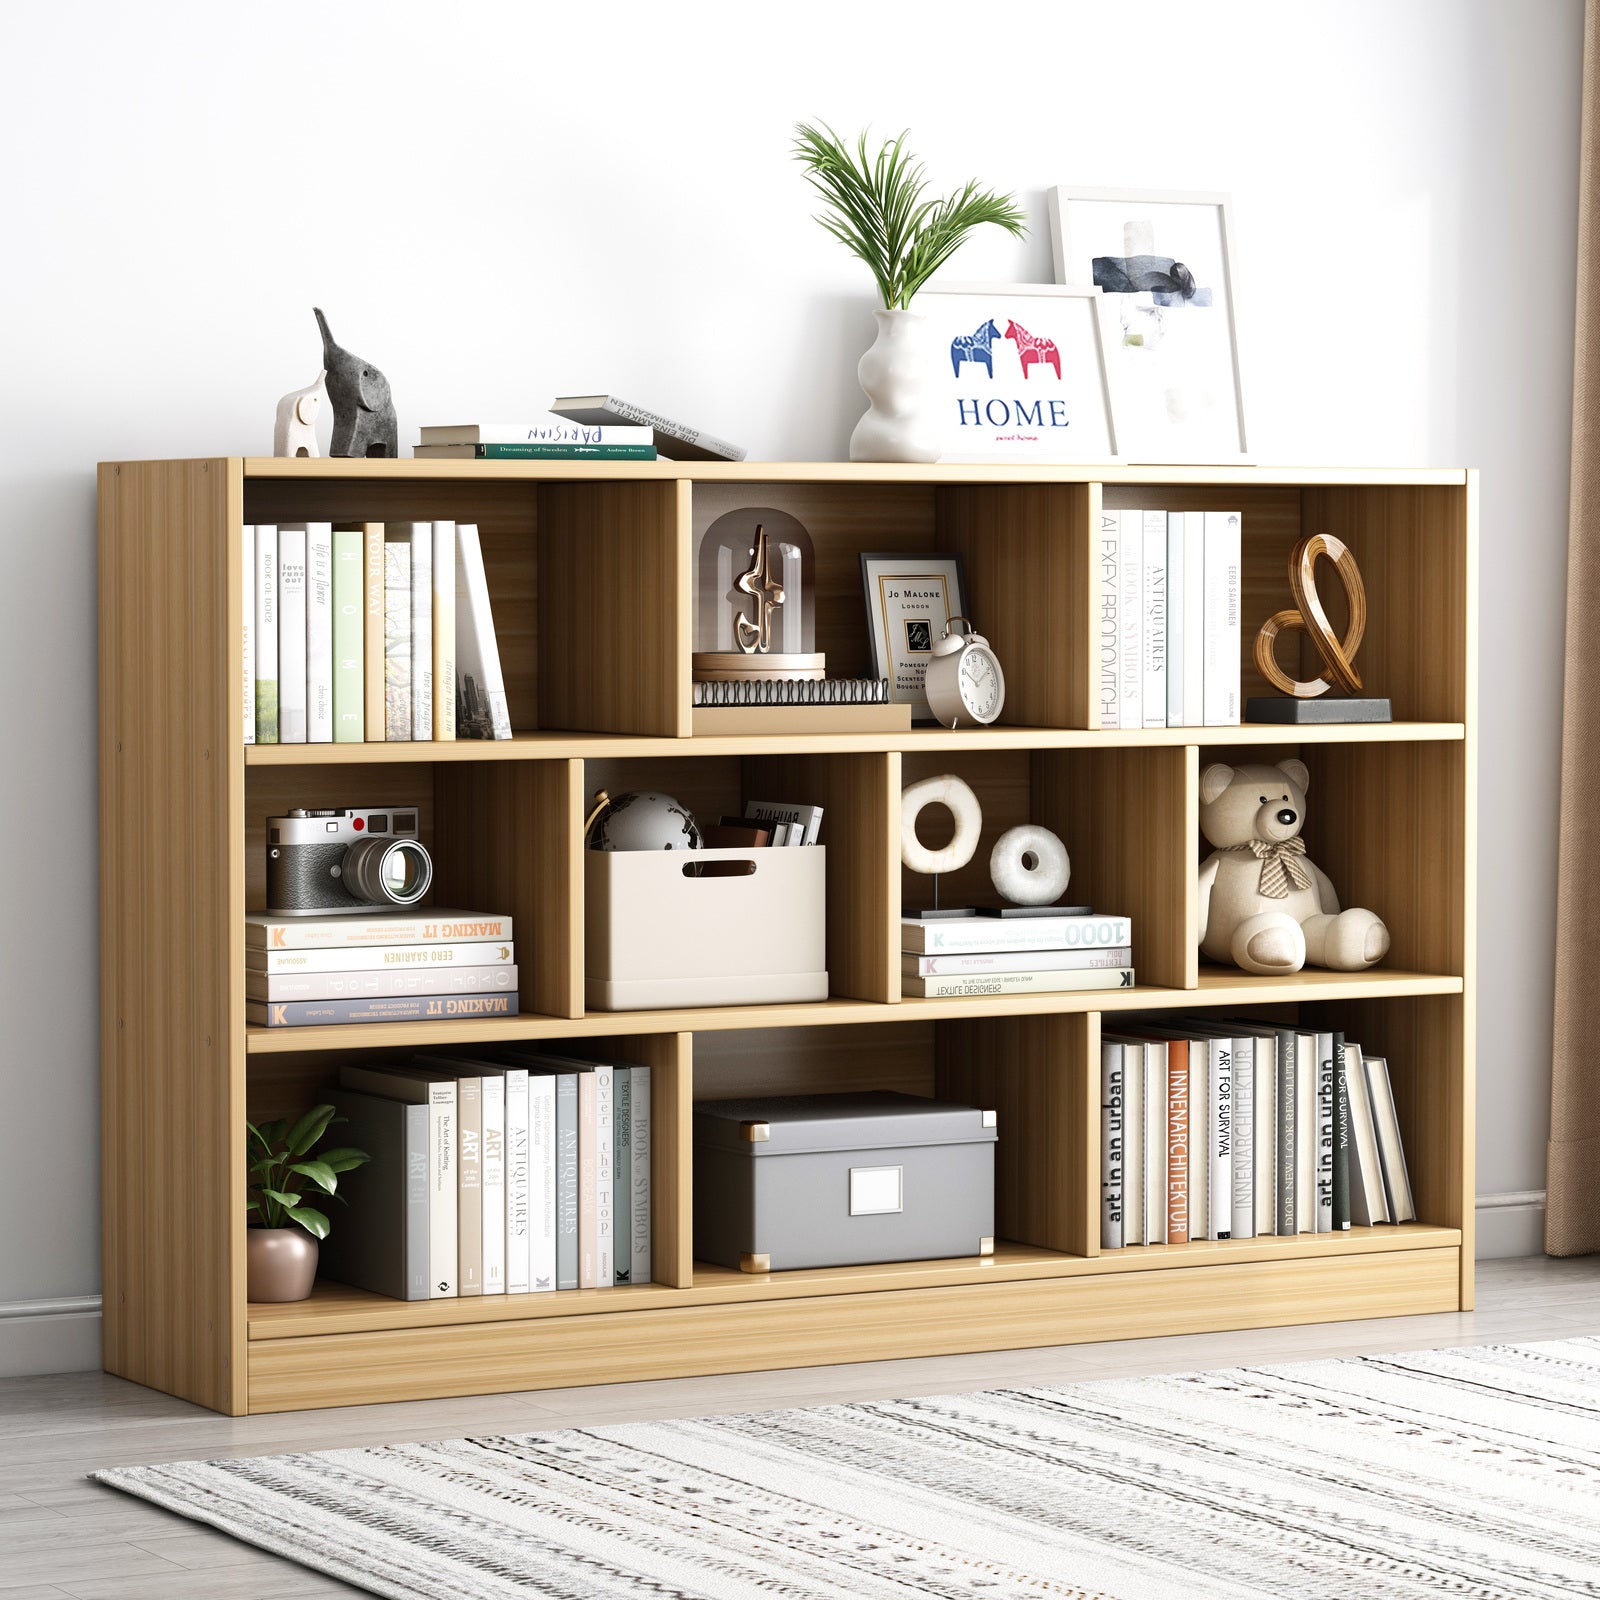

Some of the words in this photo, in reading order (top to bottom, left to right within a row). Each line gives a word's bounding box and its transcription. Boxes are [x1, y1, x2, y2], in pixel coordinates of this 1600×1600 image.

[610, 397, 680, 432] PRIMZAHLEN
[615, 408, 677, 437] EINSAMKEIT
[956, 398, 1070, 427] HOME
[528, 425, 602, 445] PARISIAN
[679, 431, 697, 444] DIE
[682, 426, 700, 438] DER
[1016, 433, 1039, 442] home
[311, 543, 330, 558] life
[369, 533, 381, 577] YOUR
[282, 563, 304, 571] love
[316, 560, 328, 568] is
[1228, 566, 1237, 585] EERO
[311, 577, 330, 605] flower
[1124, 562, 1138, 606] BOOK
[369, 583, 381, 616] WAY
[1228, 587, 1237, 627] SAARINEN
[1150, 565, 1165, 672] ANTIQUAIRES
[341, 552, 358, 721] HOME
[1124, 622, 1138, 699] SYMBOLS
[423, 671, 433, 690] love
[442, 659, 454, 695] stronger
[318, 684, 328, 700] chris
[423, 690, 432, 700] in
[318, 700, 328, 720] choice
[420, 701, 433, 731] prague
[445, 696, 453, 717] than
[445, 719, 453, 733] sin
[272, 927, 287, 947] K
[422, 924, 438, 939] IT
[441, 922, 502, 938] MAKING
[1064, 921, 1125, 946] 1000
[277, 957, 307, 965] ASSOULINE
[384, 951, 428, 963] SAARINEN
[431, 950, 453, 961] EERO
[925, 958, 938, 973] K
[1090, 958, 1122, 967] TEXTILES
[1119, 971, 1132, 987] K
[272, 1004, 288, 1025] K
[426, 1000, 443, 1015] IT
[446, 997, 509, 1014] MAKING
[1219, 1050, 1231, 1072] ART
[1337, 1043, 1346, 1065] ART
[621, 1080, 630, 1107] TEXTILE
[1218, 1076, 1231, 1101] FOR
[1284, 1041, 1294, 1121] REVOLUTION
[1317, 1059, 1333, 1118] urban
[1337, 1069, 1347, 1094] FOR
[1102, 1071, 1122, 1131] urban
[621, 1108, 630, 1147] DESIGNERS
[1218, 1104, 1231, 1158] SURVIVAL
[1234, 1050, 1253, 1209] INNENARCHITEKTUR
[1321, 1124, 1333, 1147] an
[1338, 1097, 1349, 1149] SURVIVAL
[443, 1138, 450, 1146] of
[462, 1129, 479, 1164] ART
[486, 1128, 502, 1161] ART
[543, 1121, 551, 1165] Contemporary
[634, 1119, 648, 1162] BOOK
[1109, 1137, 1122, 1162] an
[1170, 1070, 1187, 1233] INNENARCHITEKTUR
[1284, 1124, 1294, 1158] LOOK
[410, 1151, 427, 1182] ART
[442, 1146, 450, 1171] Knitting
[1317, 1153, 1333, 1173] in
[513, 1127, 527, 1236] ANTIQUAIRES
[562, 1128, 577, 1234] ANTIQUAIRES
[1103, 1168, 1122, 1187] in
[1284, 1161, 1294, 1190] NEW
[1317, 1179, 1333, 1208] art
[634, 1178, 648, 1254] SYMBOLS
[1106, 1192, 1122, 1223] art
[616, 1269, 630, 1281] K
